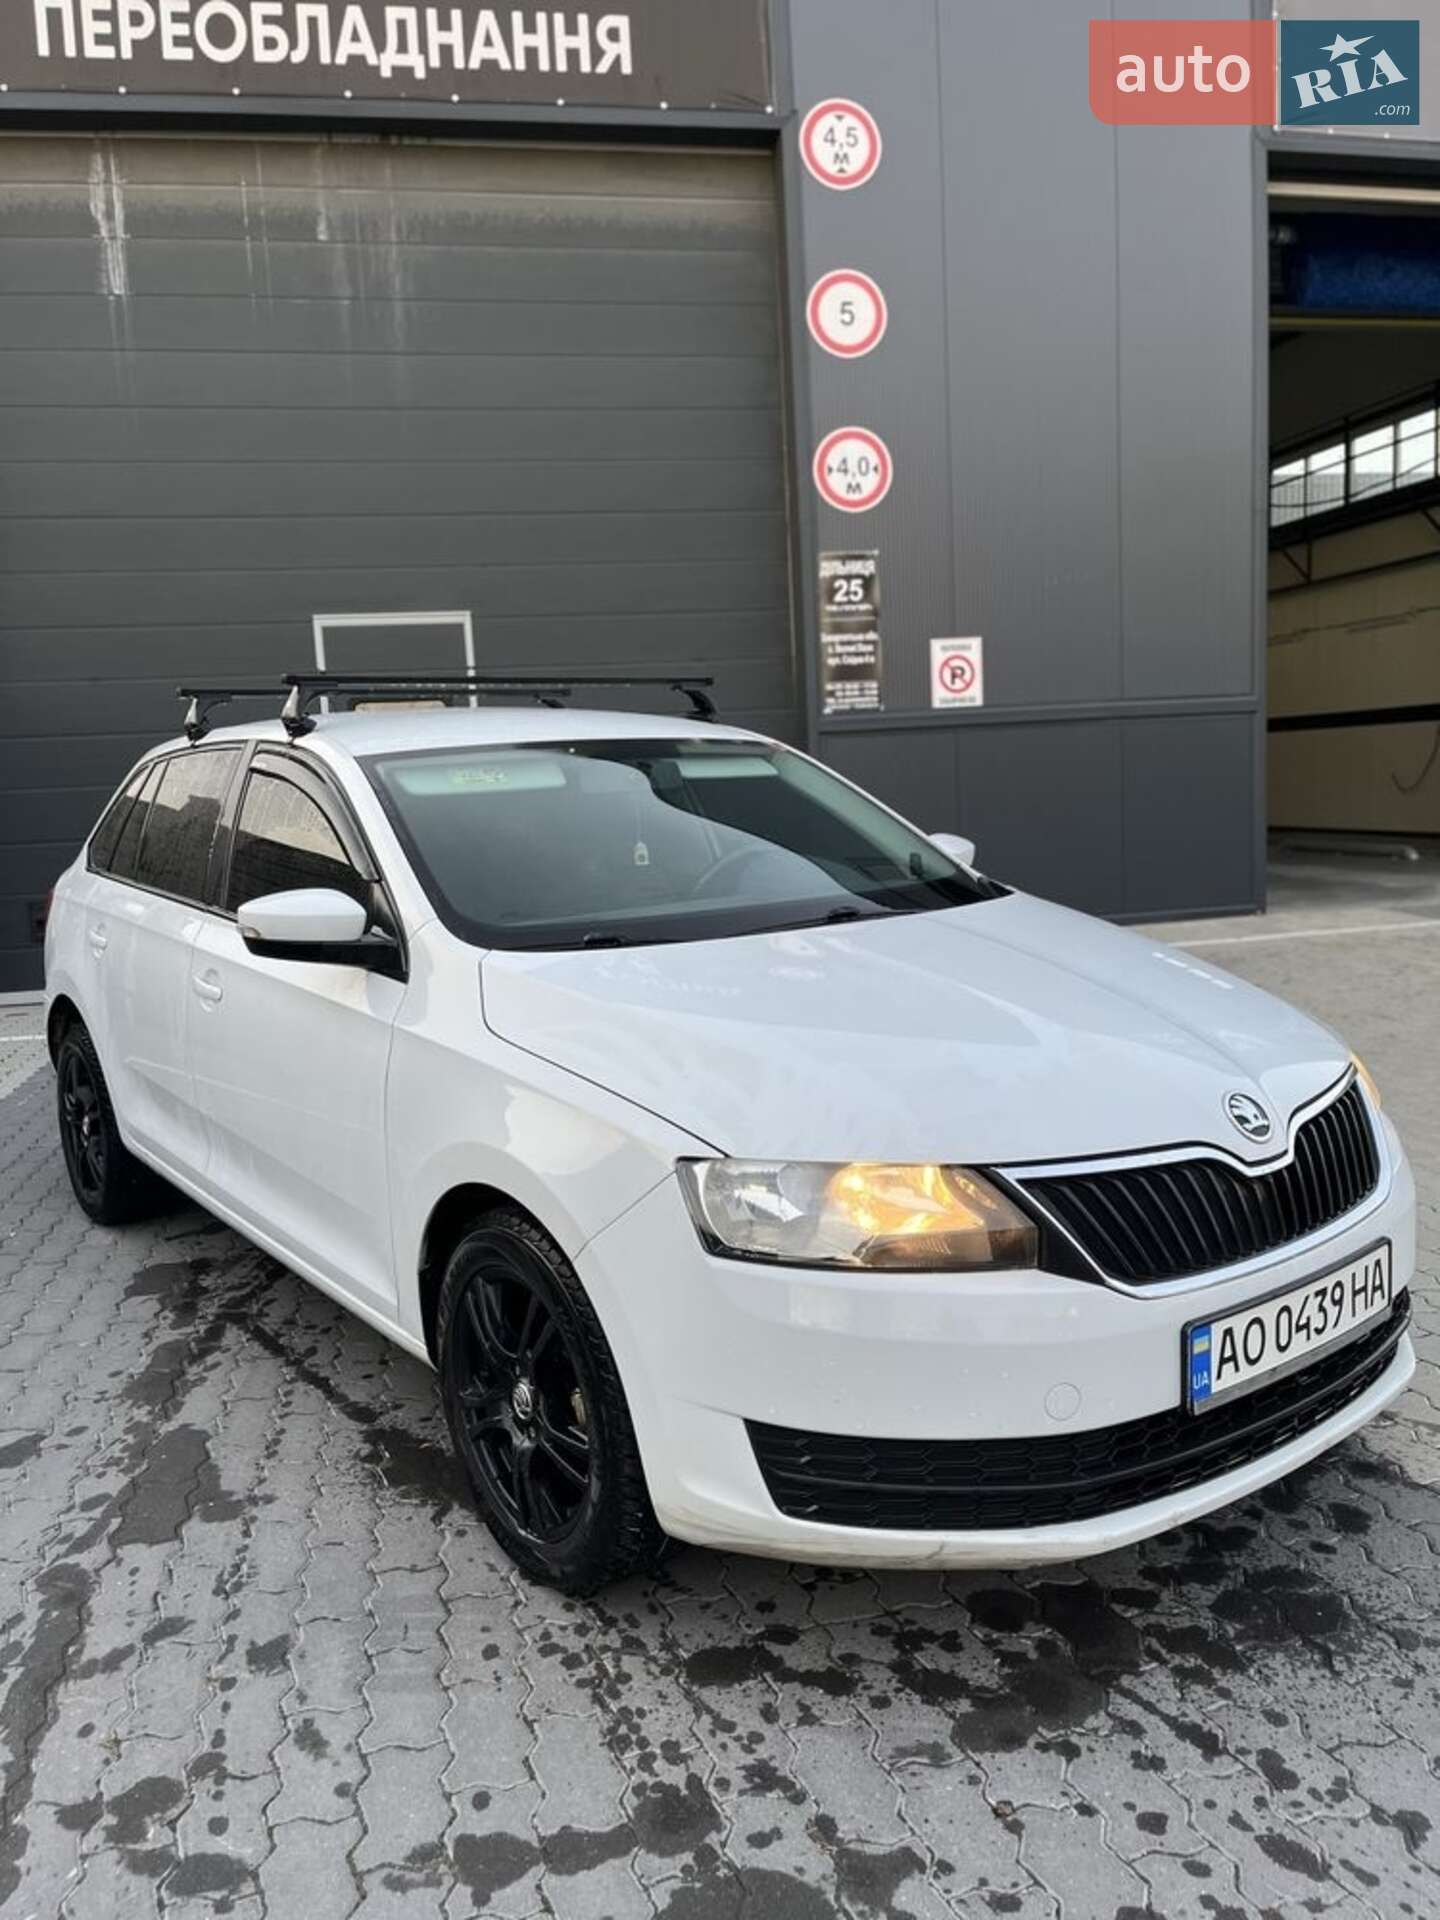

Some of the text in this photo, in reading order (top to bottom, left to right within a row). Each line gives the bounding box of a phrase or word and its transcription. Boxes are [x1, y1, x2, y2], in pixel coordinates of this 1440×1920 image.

[34, 0, 634, 79] ПЕРЕОБЛАДНАННЯ
[823, 126, 859, 151] 4,5
[840, 300, 855, 326] 5
[836, 457, 870, 480] 4,0
[833, 578, 864, 603] 25
[1216, 1258, 1385, 1381] AO 0439 HA
[1193, 1370, 1210, 1389] UA
